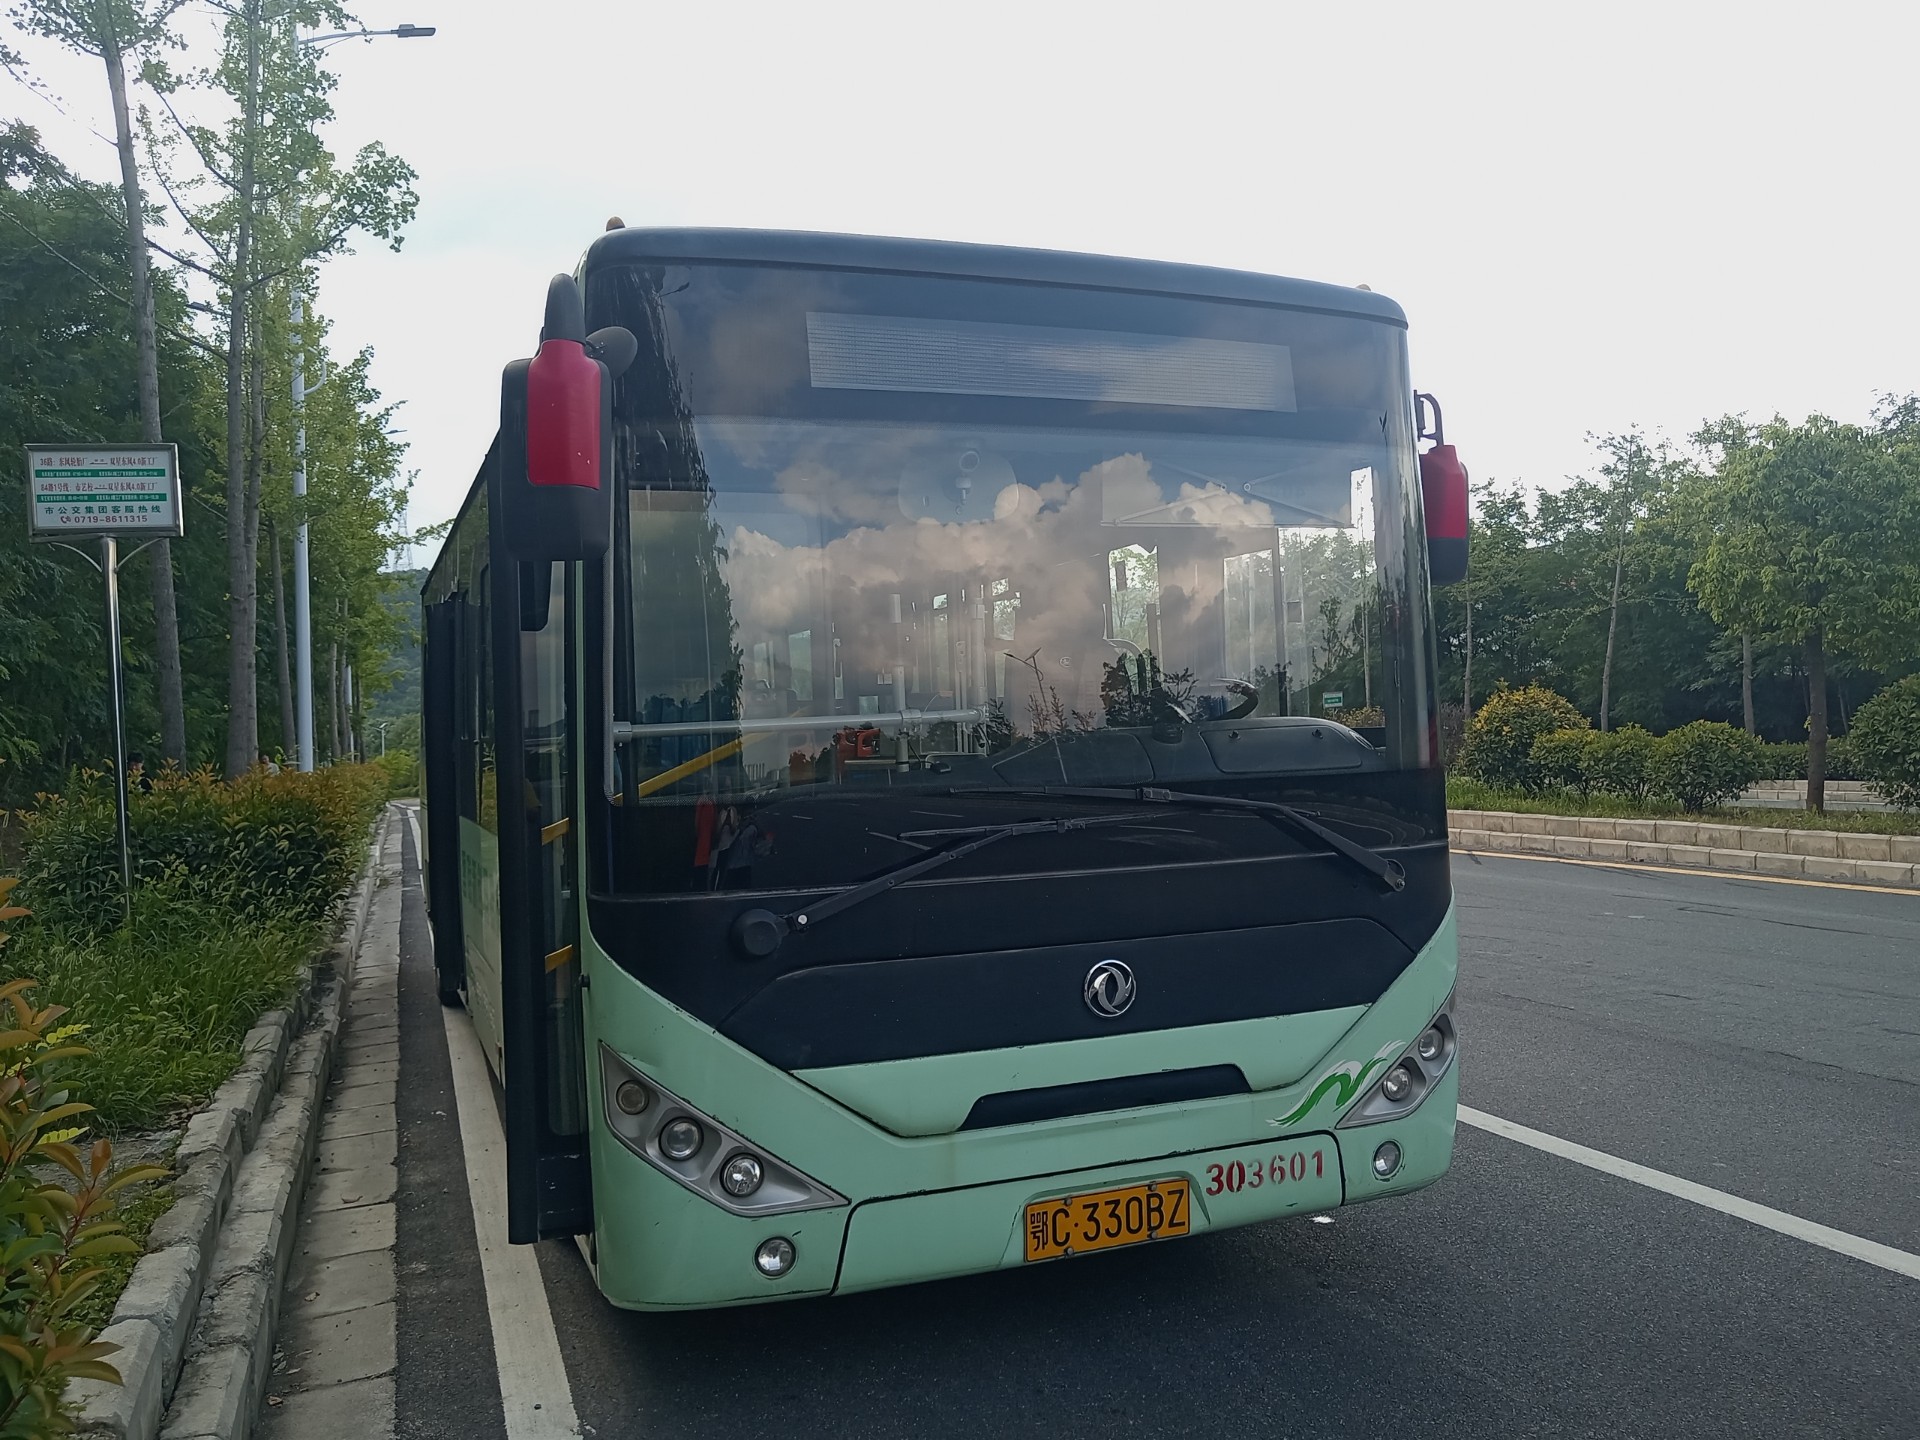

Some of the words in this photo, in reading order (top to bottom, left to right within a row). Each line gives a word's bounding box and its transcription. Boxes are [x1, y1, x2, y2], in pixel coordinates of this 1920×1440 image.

[44, 505, 161, 515] 市公交集团客服热线
[74, 515, 148, 524] 0719-8611315
[1205, 1150, 1324, 1197] 303601
